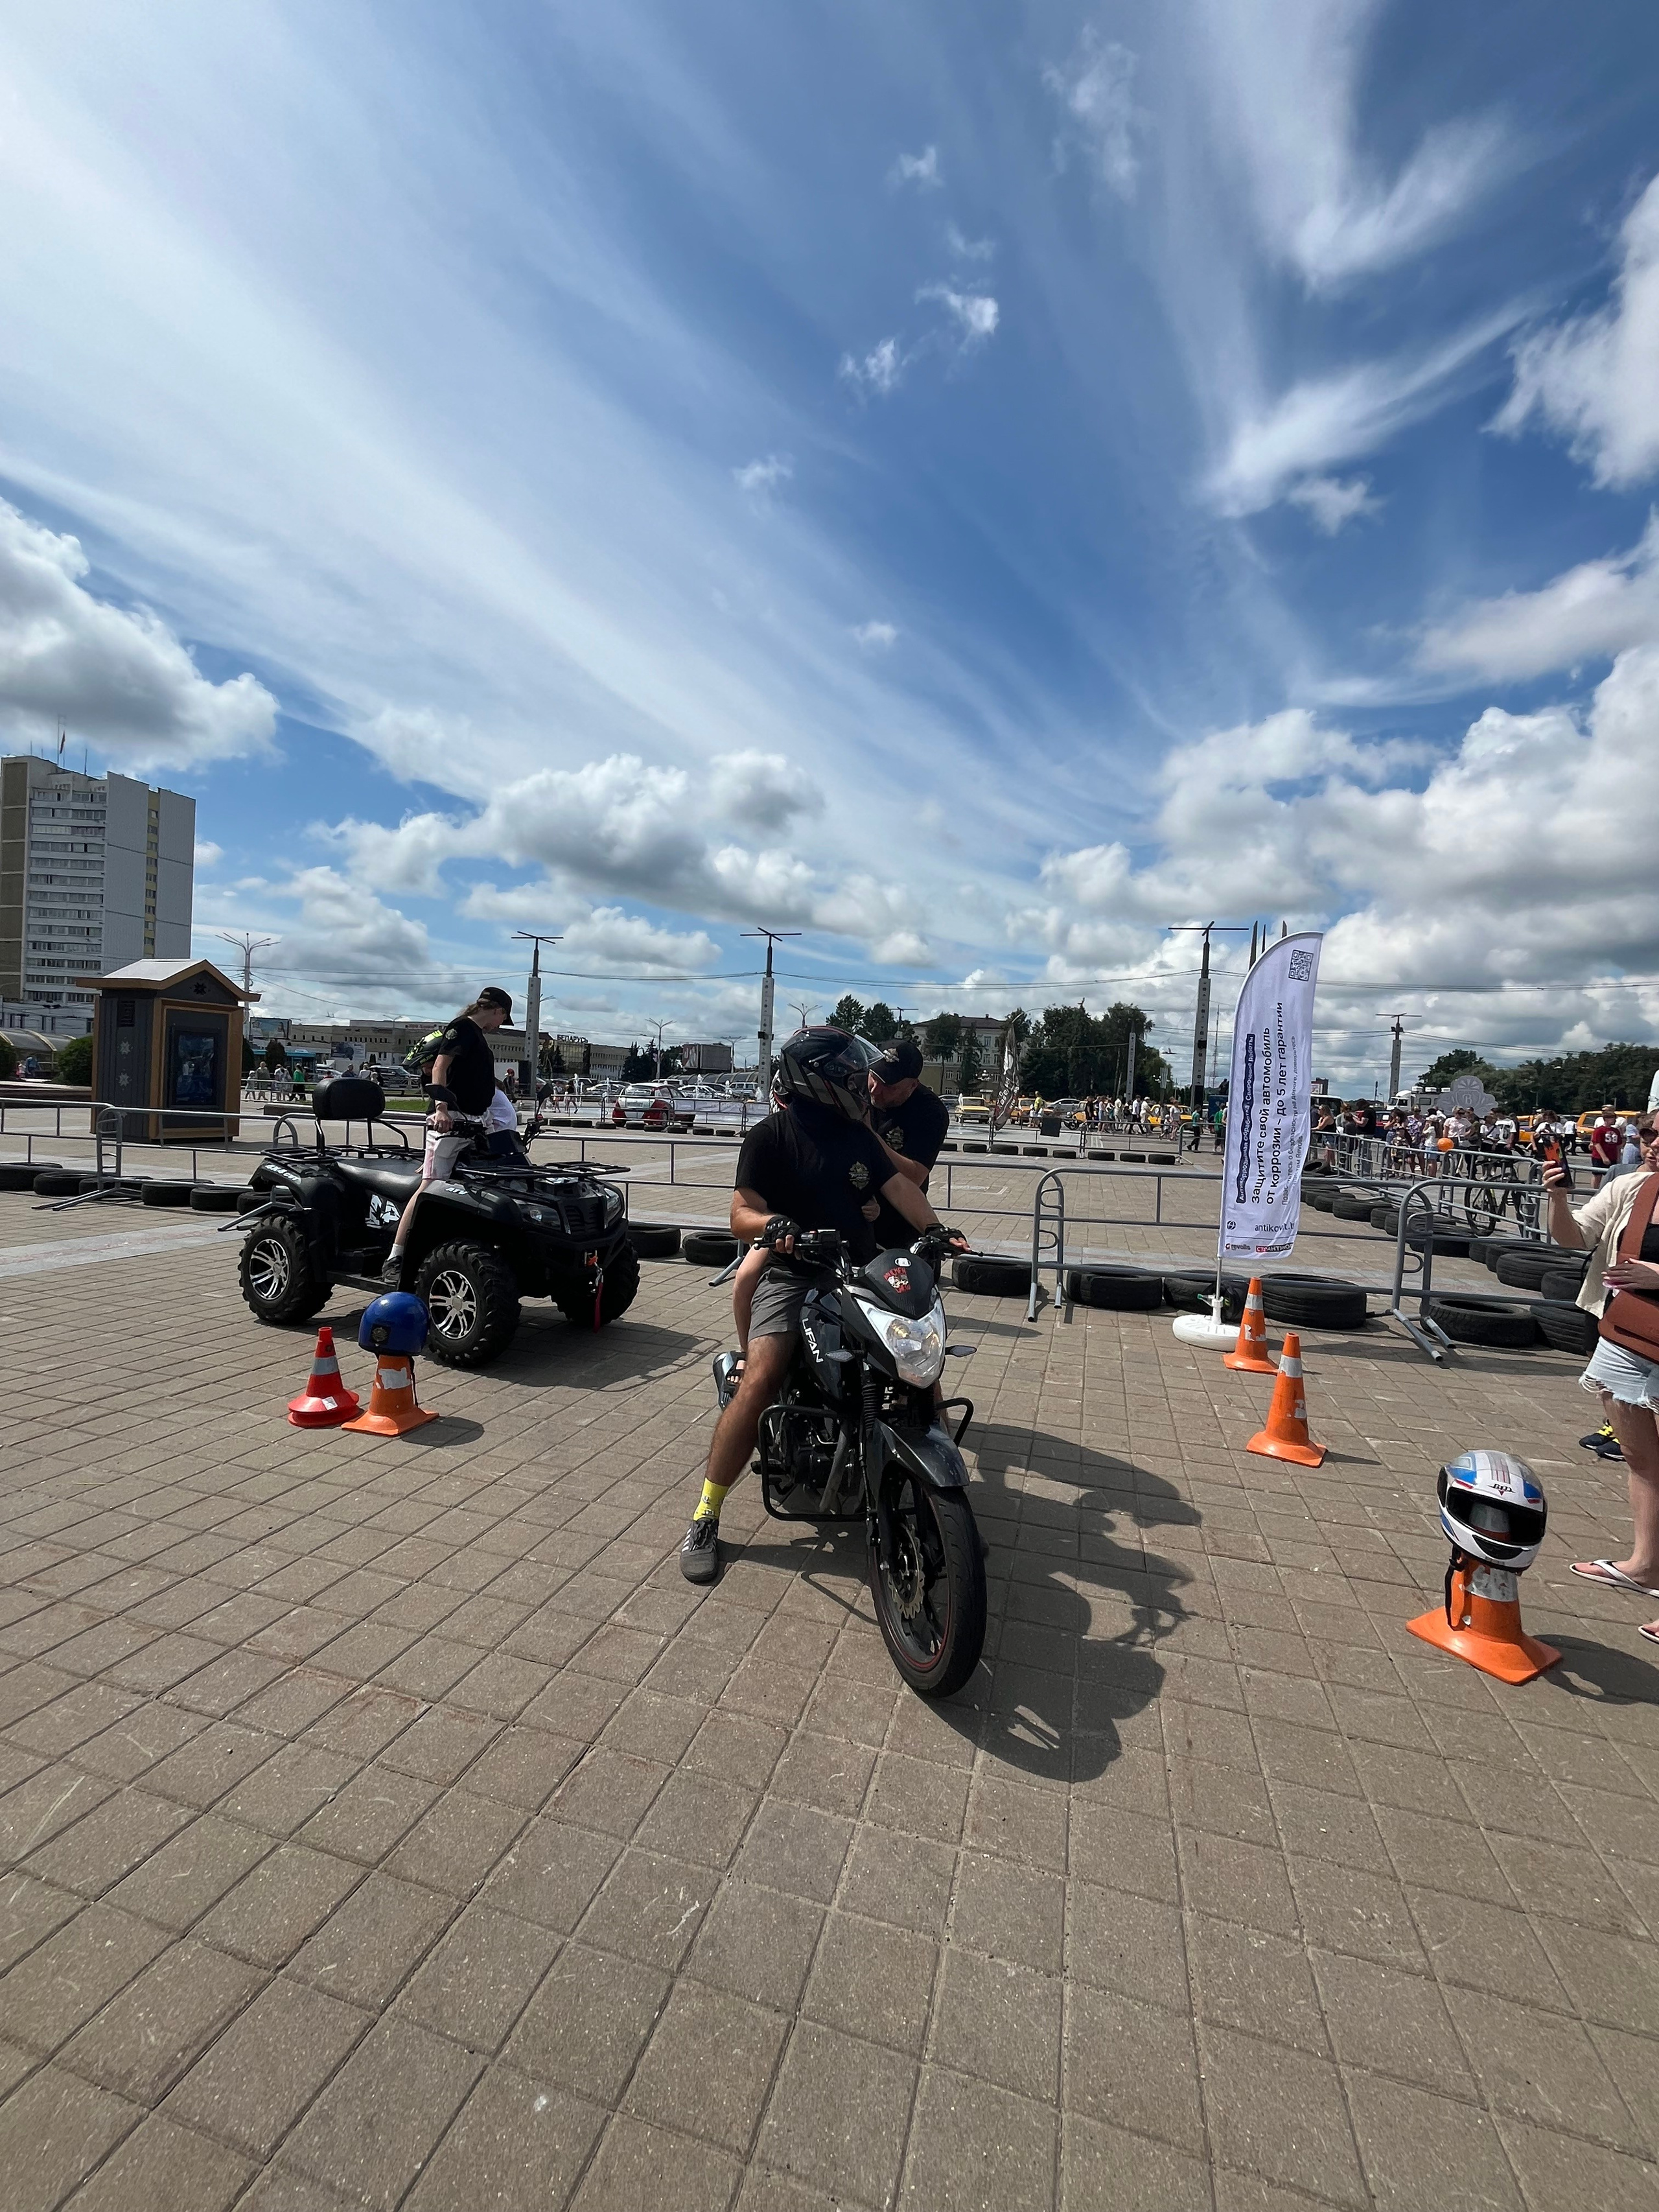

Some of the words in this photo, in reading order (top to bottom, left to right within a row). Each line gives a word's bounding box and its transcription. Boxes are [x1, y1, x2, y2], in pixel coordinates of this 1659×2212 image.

[557, 1034, 588, 1043] БЕЛАРУСЬ
[1277, 1002, 1287, 1060] гарантии
[1262, 1028, 1272, 1105] автомобиль
[1279, 1062, 1287, 1086] лет
[1259, 1108, 1270, 1138] свой
[1277, 1100, 1286, 1116] до
[1251, 1141, 1266, 1204] Защитите
[1270, 1128, 1281, 1187] коррозии
[445, 1187, 469, 1195] ATV
[1266, 1190, 1275, 1204] от
[802, 1318, 824, 1363] LIFAN
